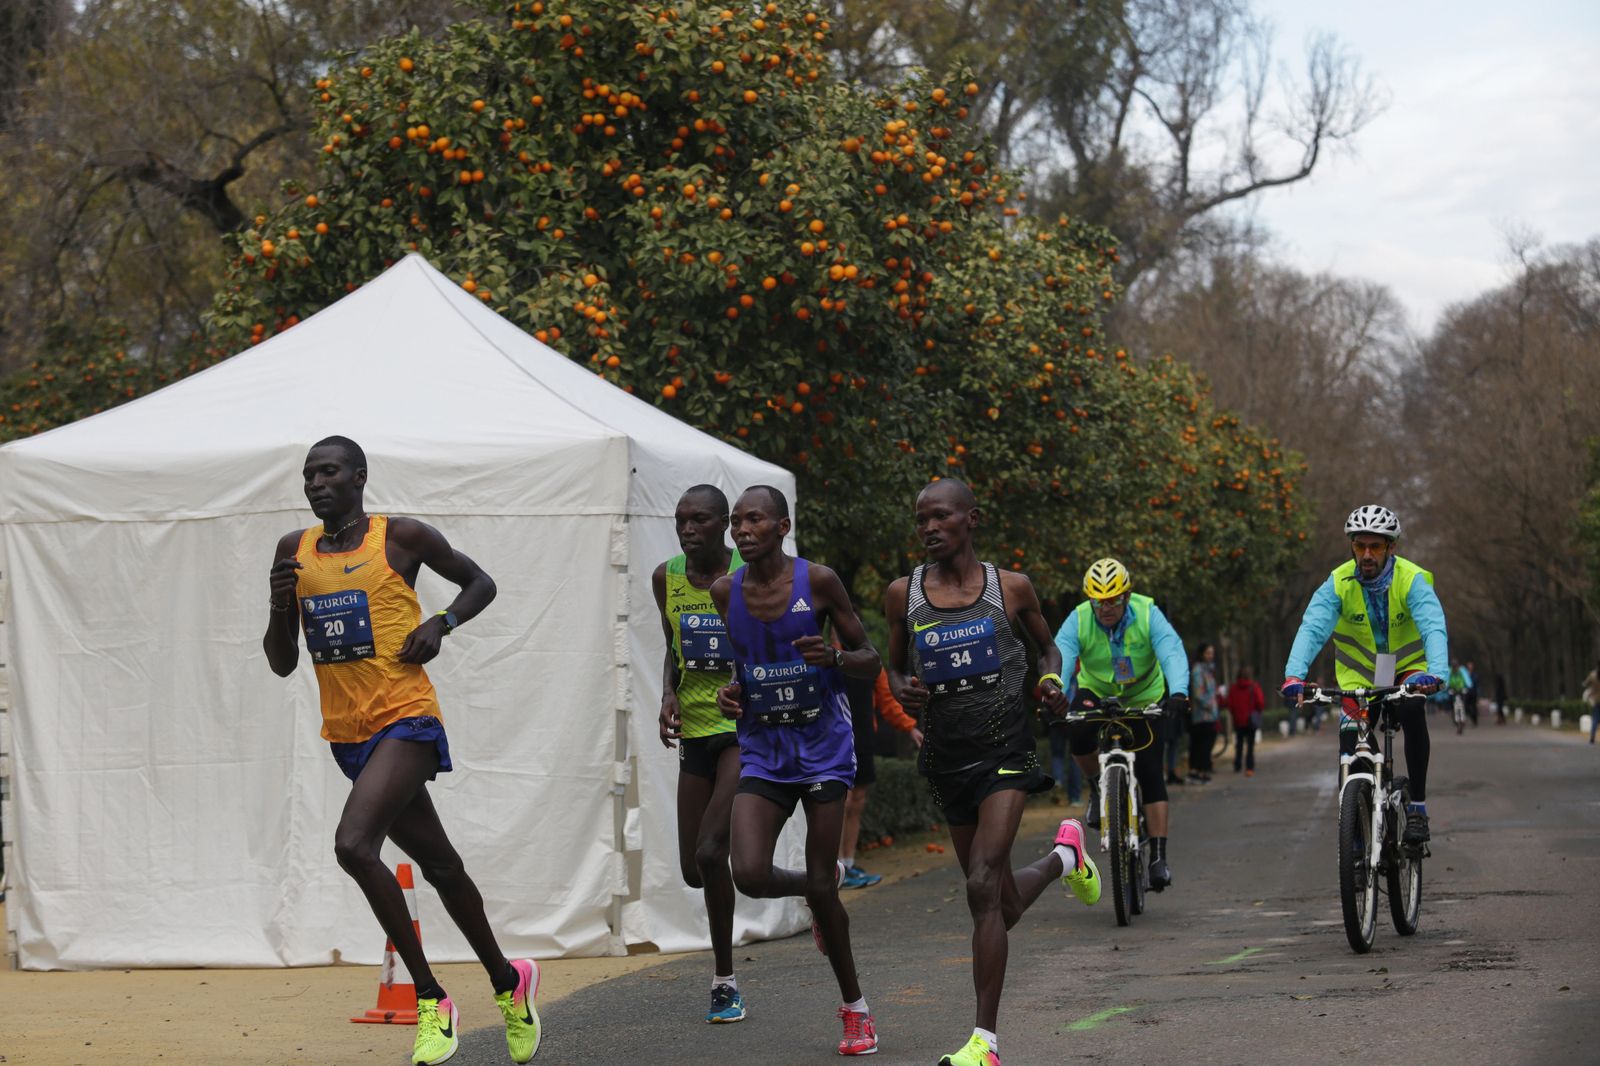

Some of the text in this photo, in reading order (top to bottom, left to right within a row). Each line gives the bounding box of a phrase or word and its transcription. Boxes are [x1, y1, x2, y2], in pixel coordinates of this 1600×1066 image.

[318, 595, 357, 609] ZURICH
[682, 602, 707, 611] team
[324, 620, 344, 637] 20
[702, 618, 725, 627] ZUR
[942, 625, 984, 641] ZURICH
[709, 636, 719, 650] 9
[950, 649, 972, 668] 34
[768, 664, 807, 678] ZURICH
[775, 687, 795, 702] 19
